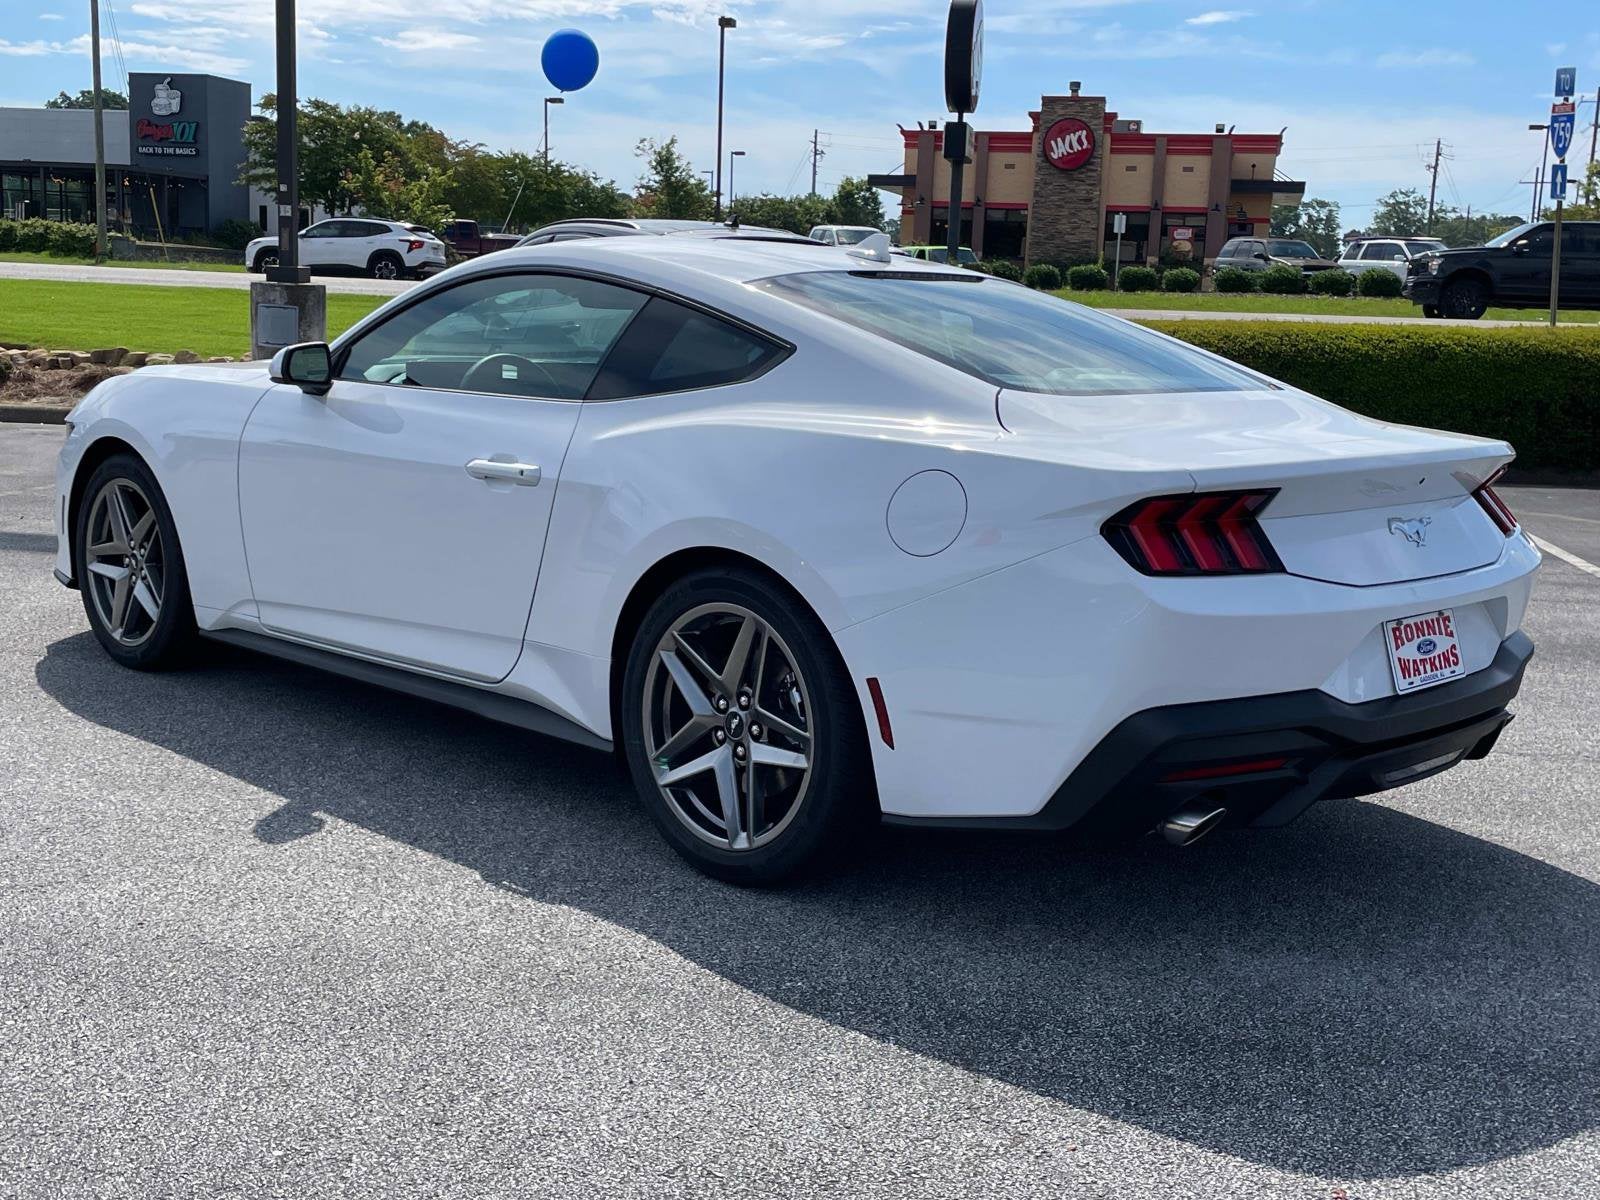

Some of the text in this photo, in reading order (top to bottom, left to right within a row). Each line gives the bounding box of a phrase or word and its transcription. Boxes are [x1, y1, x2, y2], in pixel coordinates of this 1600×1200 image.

[1560, 74, 1571, 90] TO
[168, 122, 197, 142] 101
[1553, 122, 1571, 149] 759
[175, 147, 196, 155] BASICS
[1391, 615, 1455, 651] RONNIE
[1397, 643, 1460, 680] WATKINS
